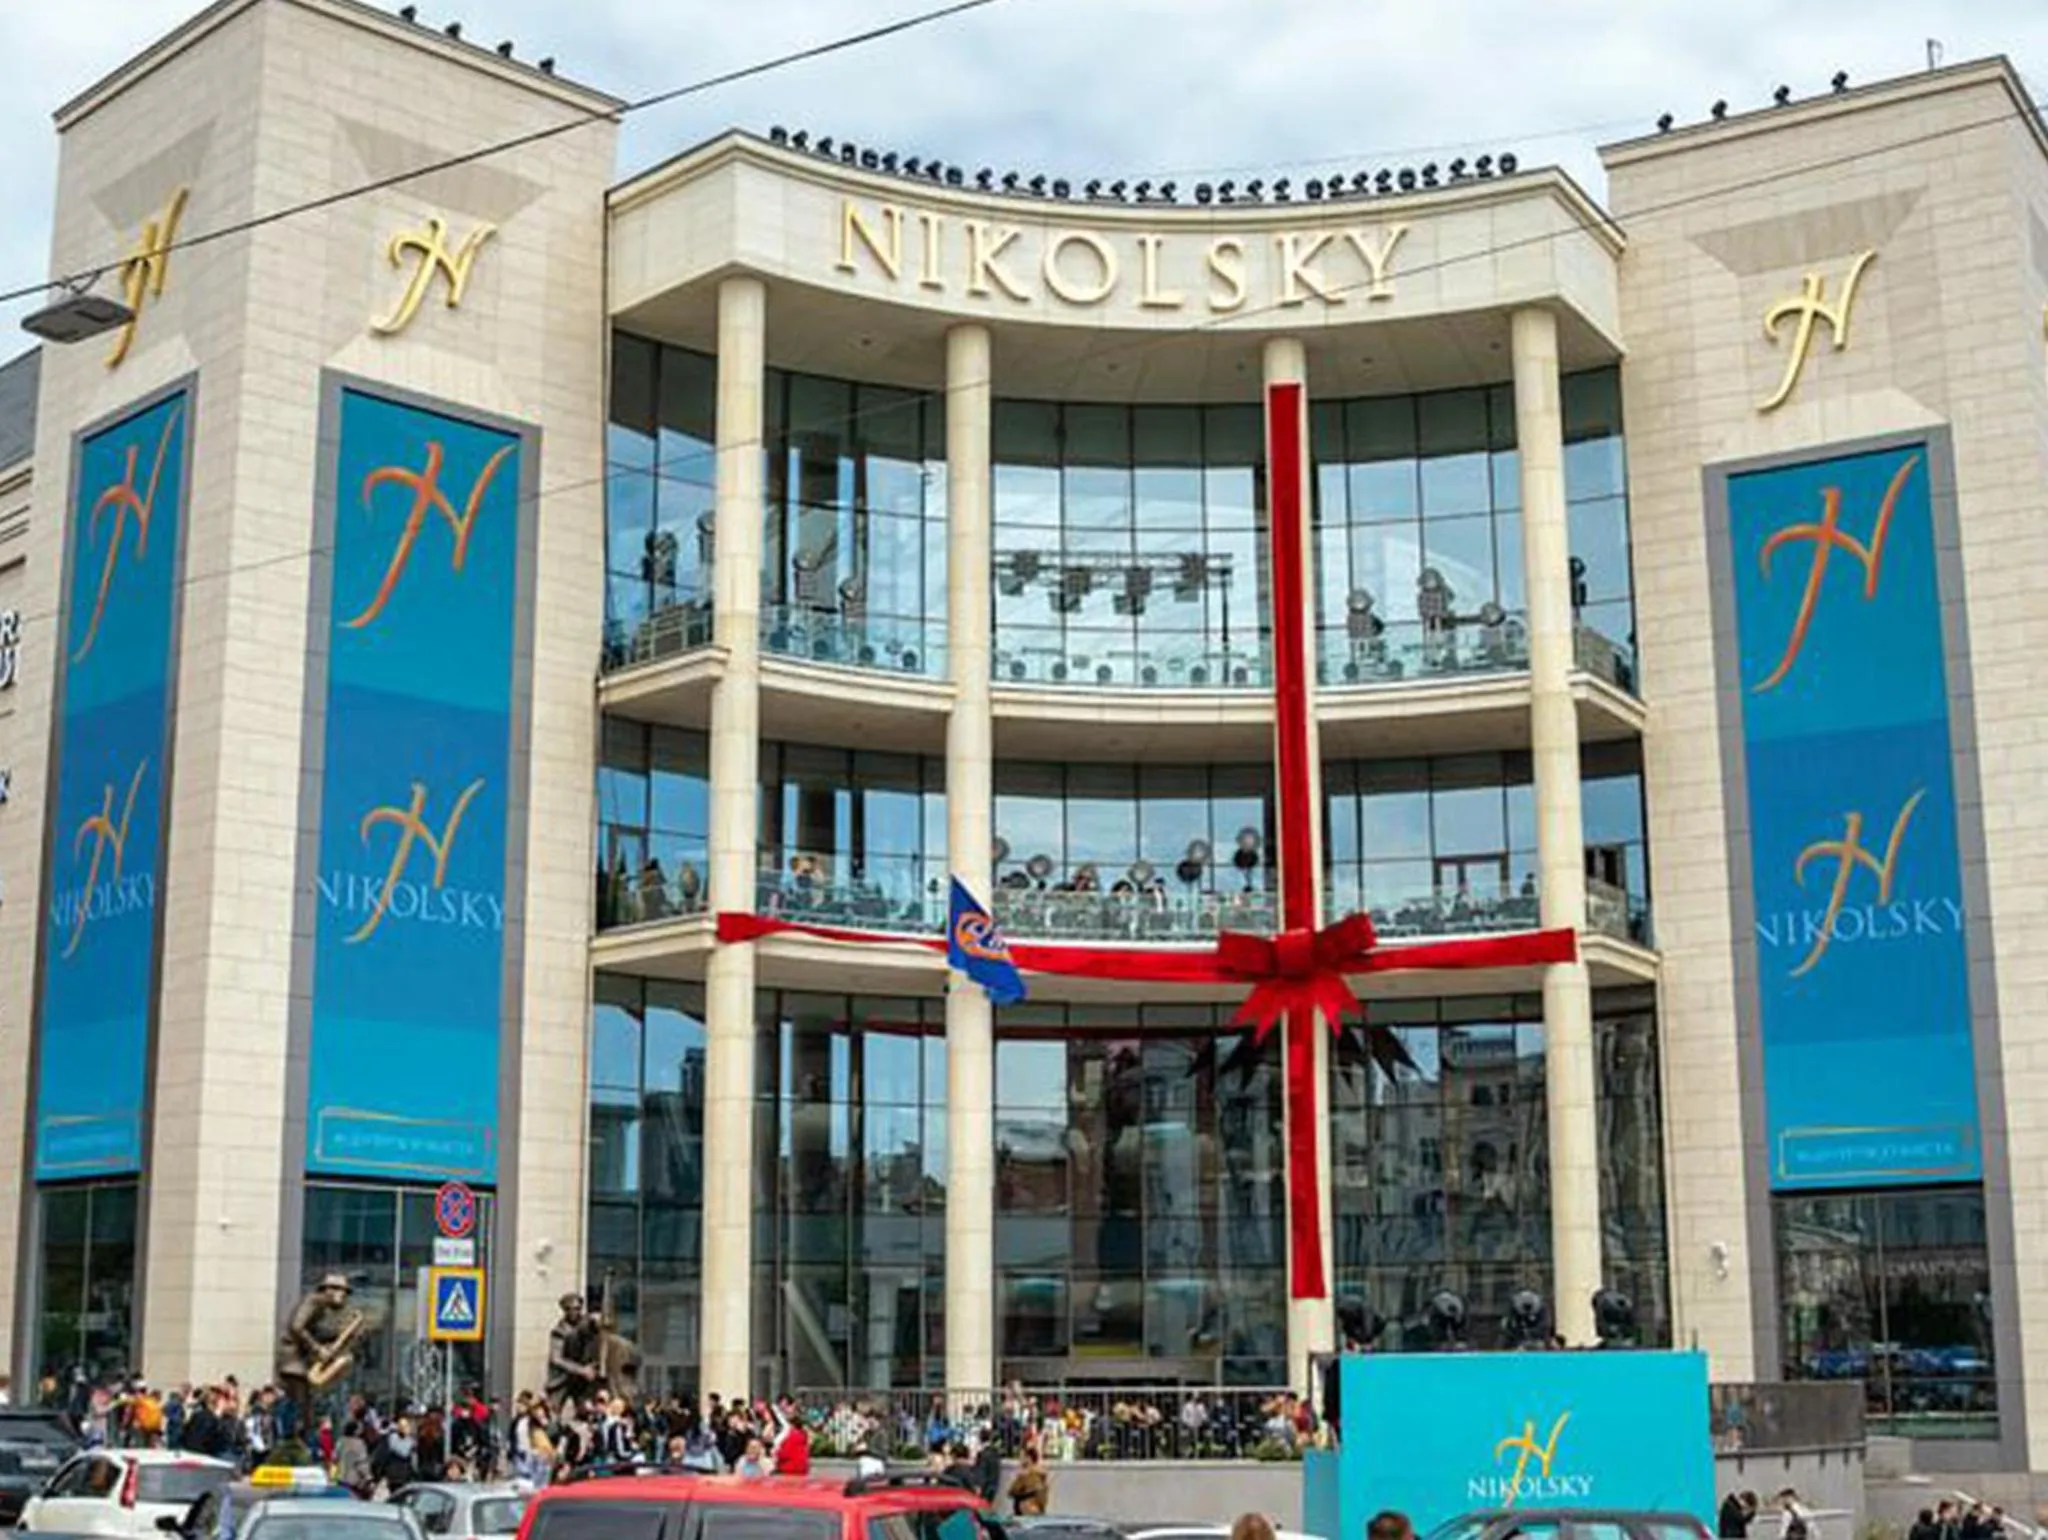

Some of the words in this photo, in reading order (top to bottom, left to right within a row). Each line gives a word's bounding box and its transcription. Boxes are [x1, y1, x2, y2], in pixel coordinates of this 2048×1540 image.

[834, 200, 1408, 313] NIKOLSKY
[315, 870, 506, 930] NIKOLSKY
[1755, 897, 1965, 947] NIKOLSKY
[1467, 1474, 1595, 1499] NIKOLSKY
